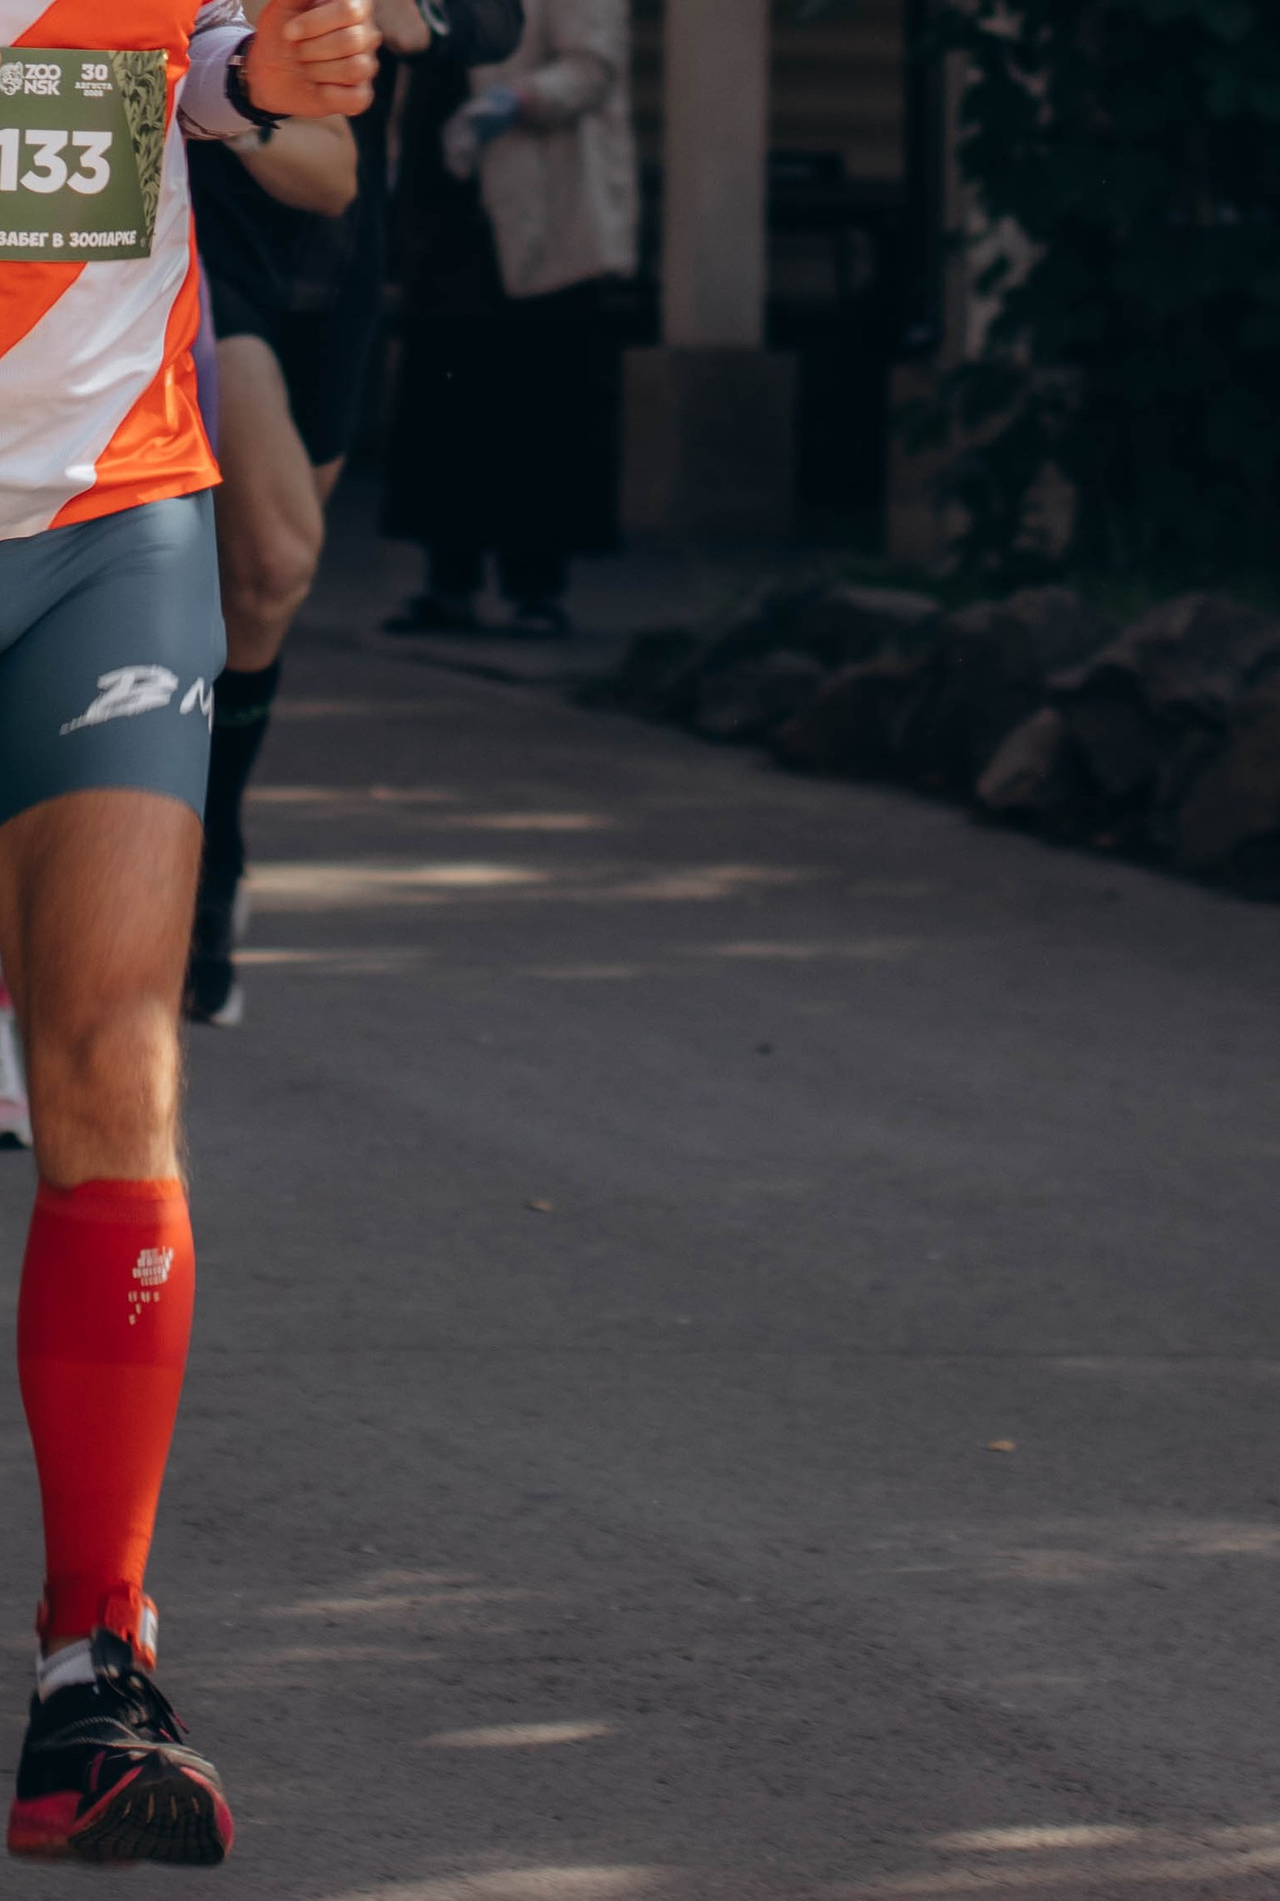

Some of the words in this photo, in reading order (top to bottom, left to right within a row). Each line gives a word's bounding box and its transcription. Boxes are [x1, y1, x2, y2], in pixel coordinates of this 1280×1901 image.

[23, 63, 62, 80] ZOO
[80, 63, 109, 81] 30
[23, 80, 61, 96] NSK
[52, 232, 64, 248] В
[68, 230, 138, 248] ЗООПАРКЕ
